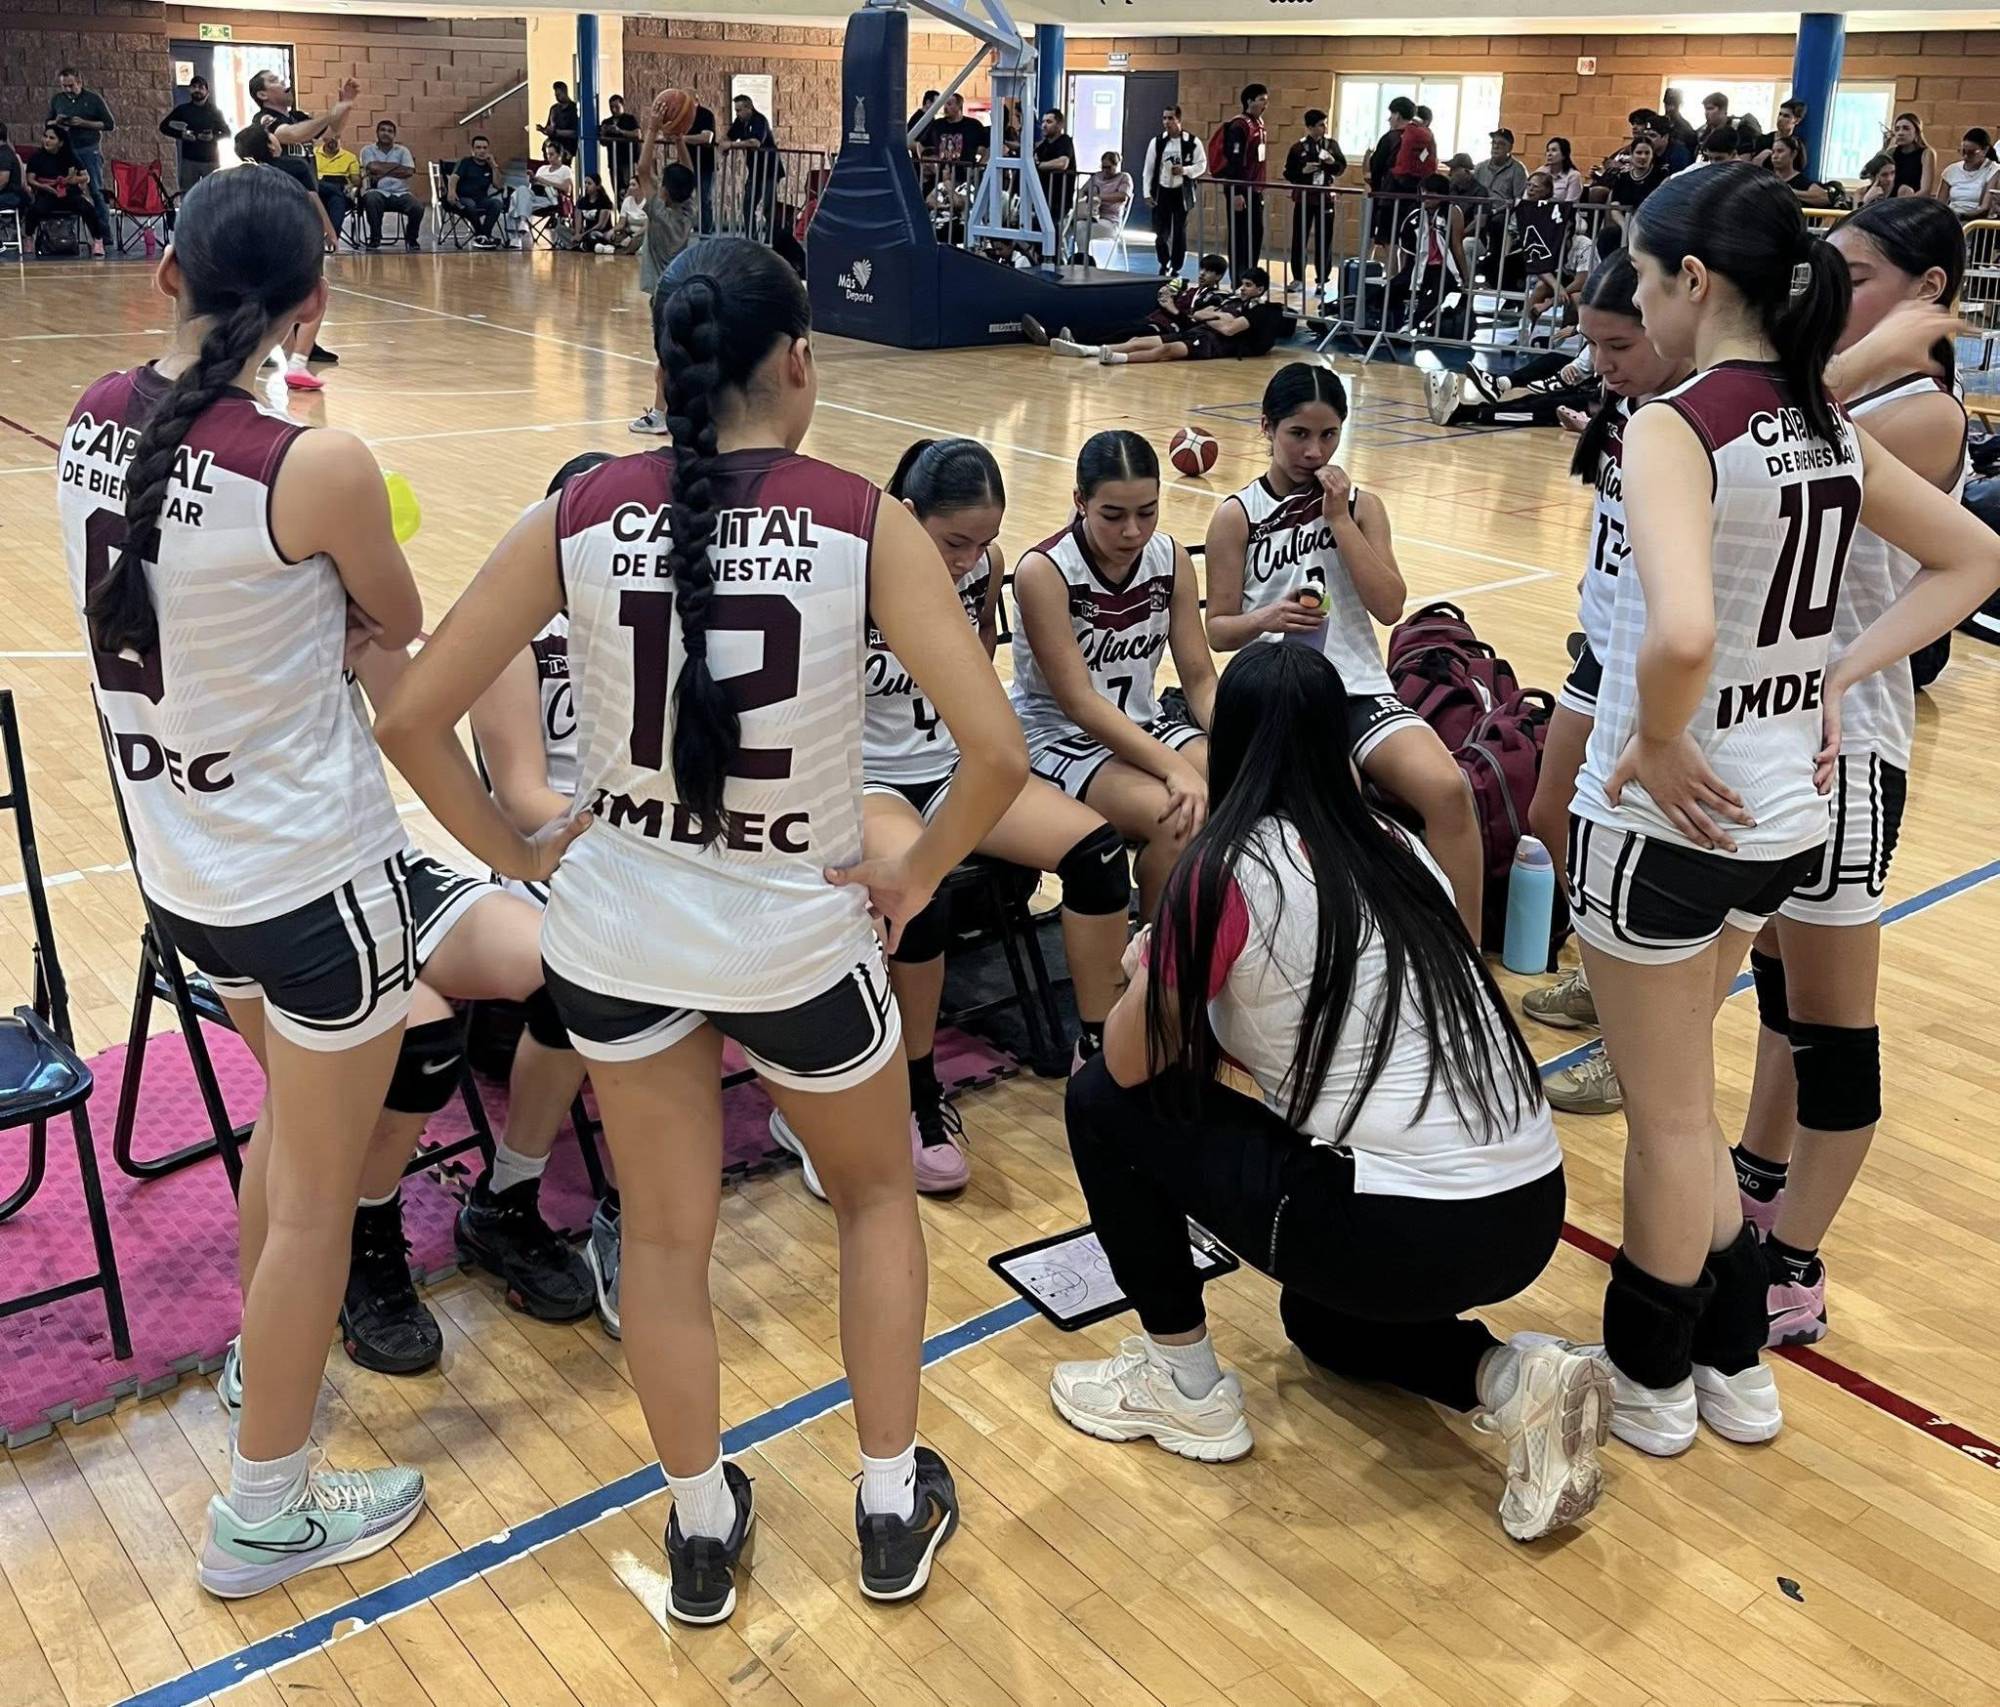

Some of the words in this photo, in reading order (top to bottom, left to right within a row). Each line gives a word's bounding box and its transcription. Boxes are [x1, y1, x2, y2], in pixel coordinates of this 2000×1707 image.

[838, 273, 855, 289] Más
[846, 289, 873, 303] Deporte
[71, 415, 213, 494] CAPAL
[1766, 452, 1794, 477] DE
[62, 460, 85, 487] DE
[89, 469, 203, 527] BIEAR
[612, 505, 819, 549] CAITAL
[1253, 525, 1338, 584] Culiac
[612, 554, 648, 577] DE
[654, 555, 814, 583] BNESTAR
[1757, 475, 1862, 648] 10
[618, 589, 801, 780] 12
[1107, 675, 1133, 716] 7
[1716, 669, 1825, 730] IMDE
[103, 713, 236, 796] DEC
